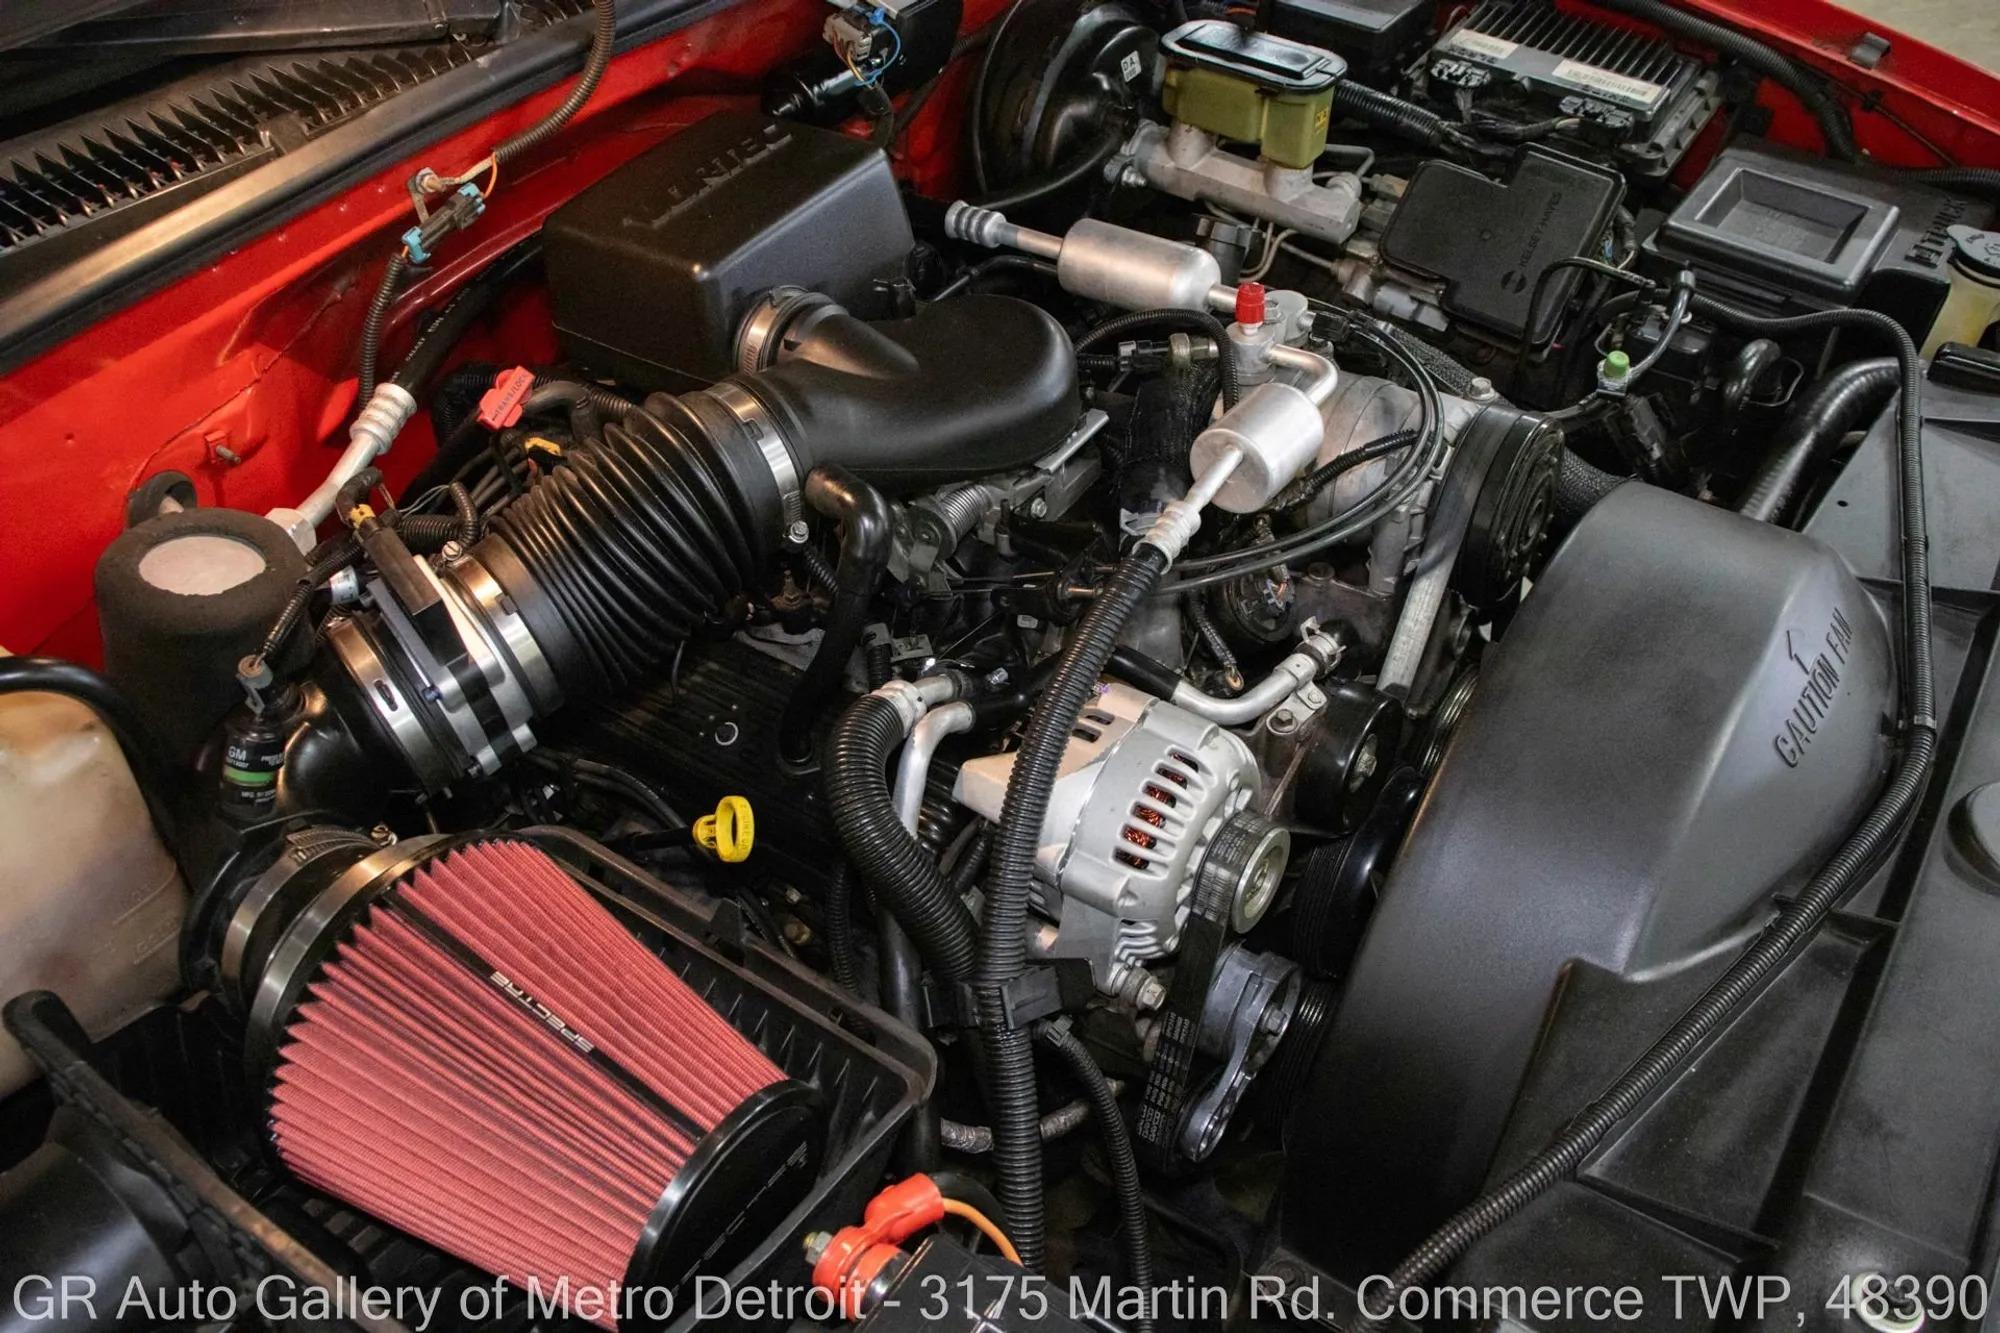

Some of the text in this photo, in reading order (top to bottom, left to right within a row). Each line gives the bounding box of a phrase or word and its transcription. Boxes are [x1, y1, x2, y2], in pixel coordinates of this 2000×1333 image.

[1773, 607, 1853, 769] CAUTION FAN
[228, 745, 248, 762] GM
[490, 971, 594, 1053] SPECTRE
